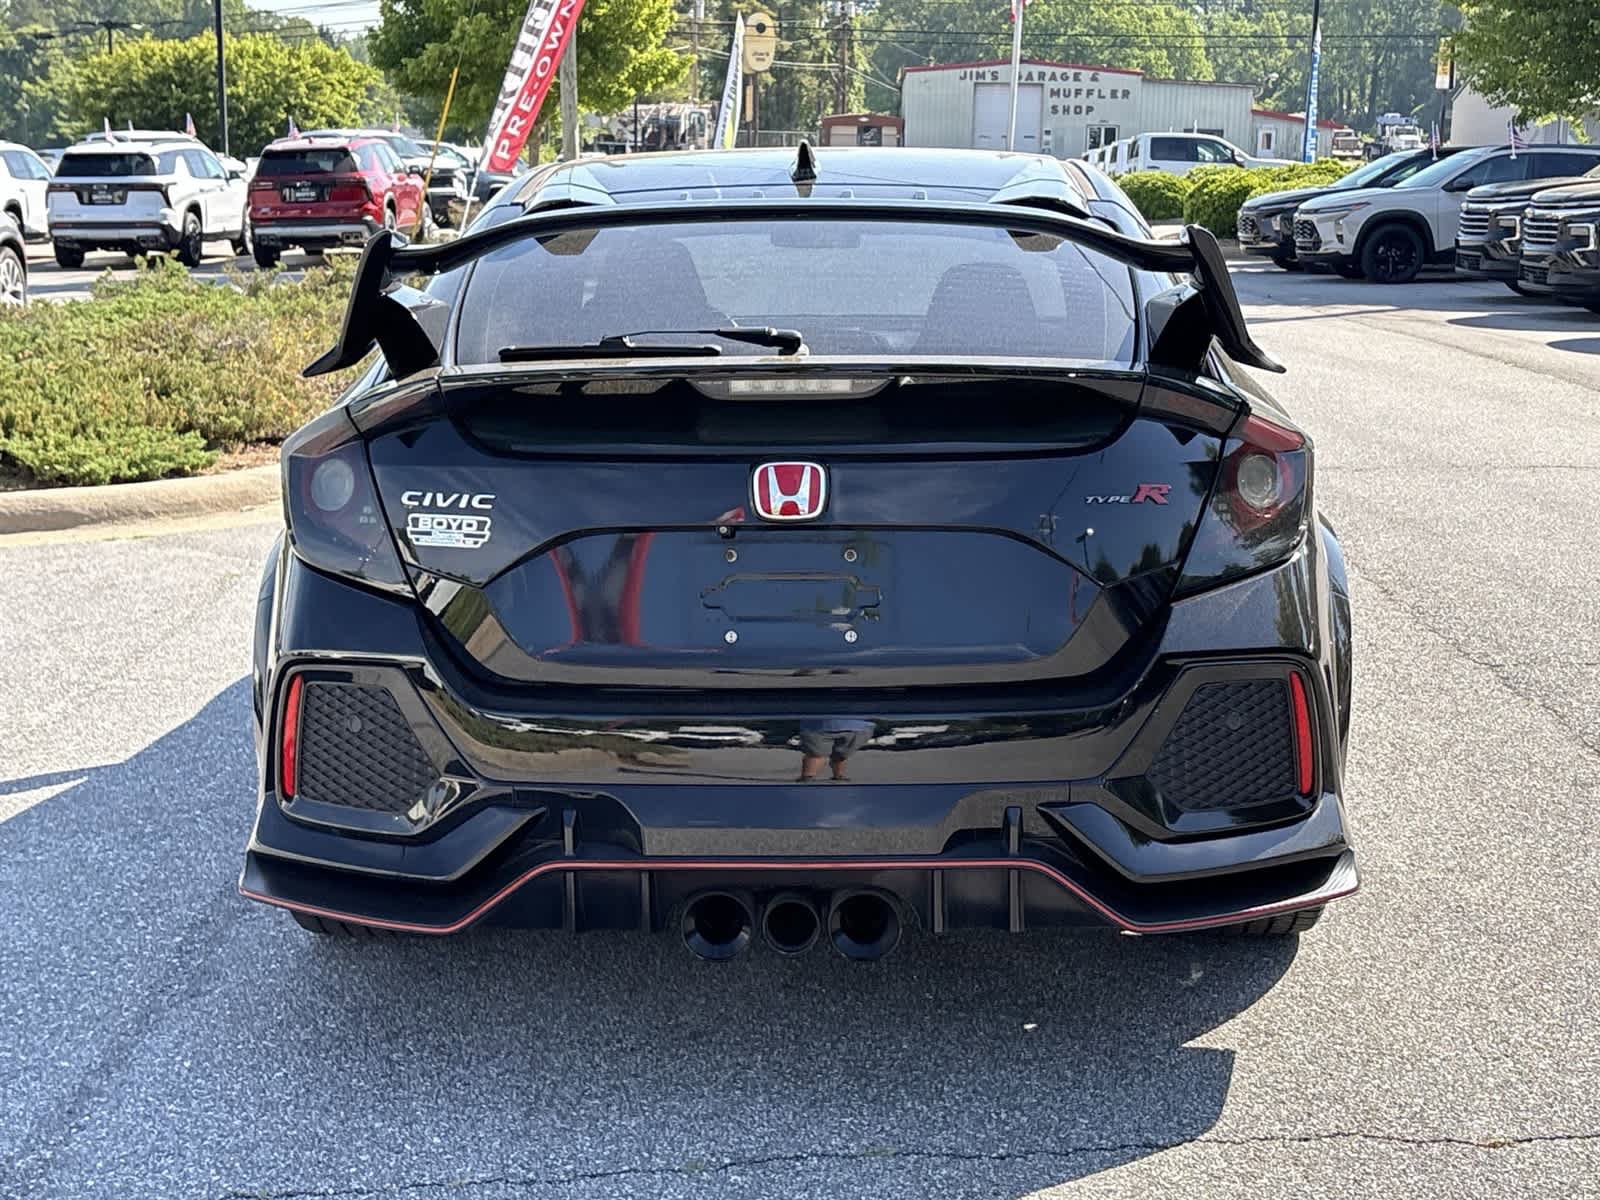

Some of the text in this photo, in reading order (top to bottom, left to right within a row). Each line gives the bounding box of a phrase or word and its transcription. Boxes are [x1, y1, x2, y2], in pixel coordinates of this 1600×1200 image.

[959, 70, 1000, 81] JIM'S
[1090, 73, 1100, 82] &
[1050, 88, 1131, 100] MUFFLER
[1050, 105, 1096, 116] SHOP
[401, 490, 496, 509] CIVIC
[1085, 483, 1172, 505] TYPE R
[418, 517, 479, 531] BOYD
